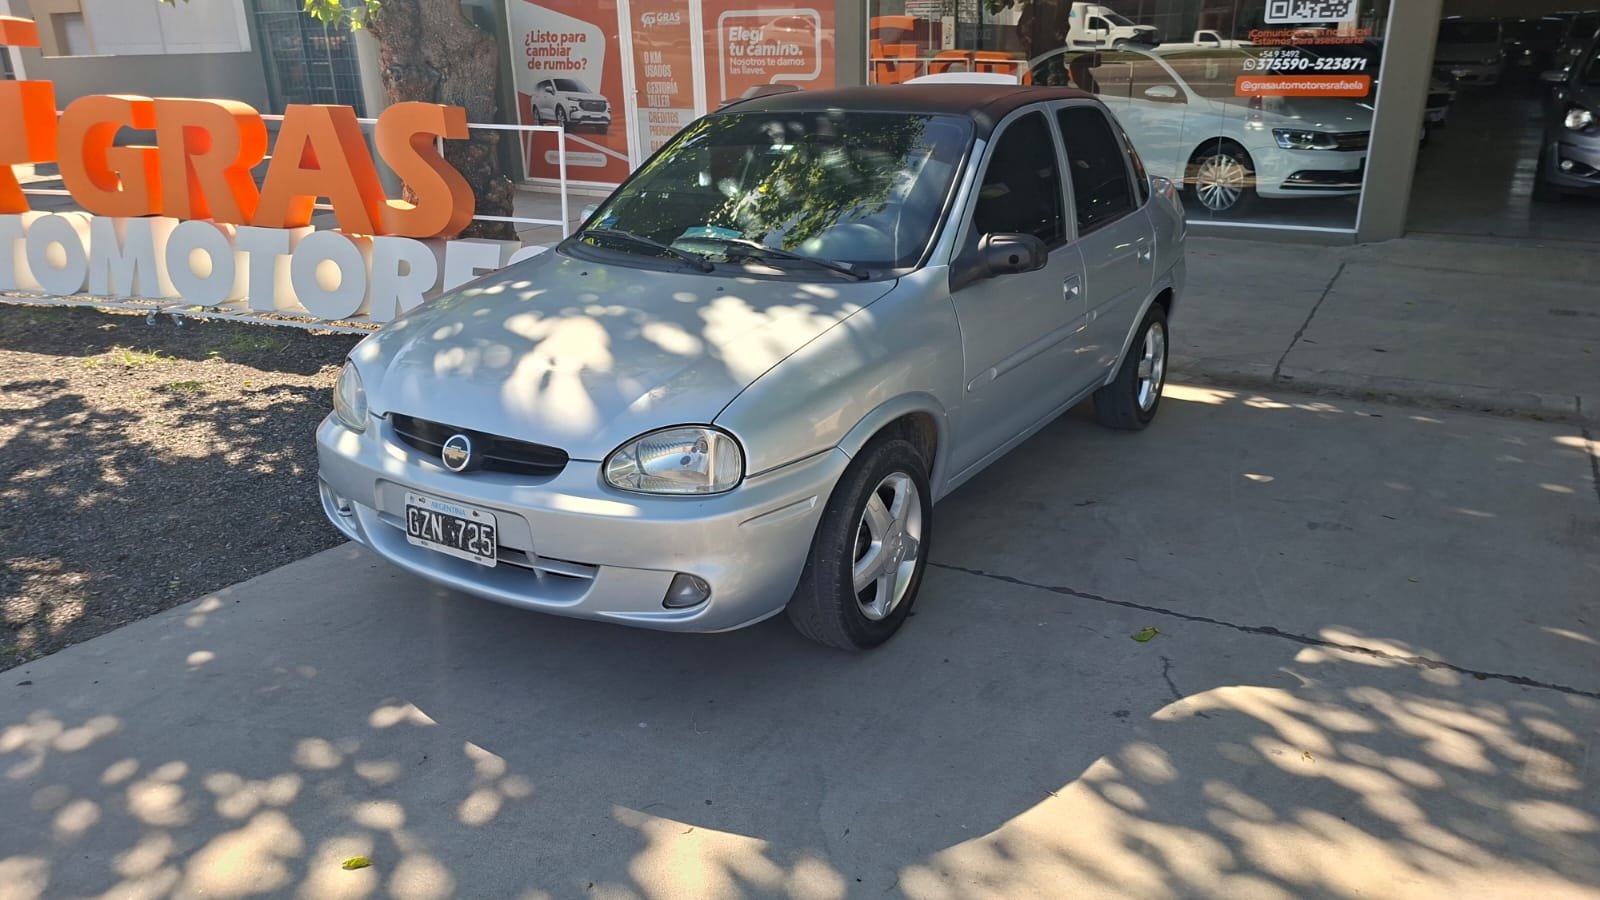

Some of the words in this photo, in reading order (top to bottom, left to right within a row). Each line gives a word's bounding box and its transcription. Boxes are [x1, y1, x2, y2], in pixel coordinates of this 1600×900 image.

[656, 12, 681, 22] GRAS
[525, 29, 558, 46] ¿Listo
[560, 33, 587, 46] para
[1253, 36, 1291, 45] Estamos
[1291, 37, 1313, 46] para
[526, 43, 571, 57] cambiar
[729, 42, 744, 56] tu
[747, 40, 803, 56] camino.
[1281, 50, 1300, 58] 3492
[528, 57, 542, 70] de
[543, 57, 588, 70] rumbo?
[730, 57, 766, 66] Nosotros
[767, 57, 776, 66] te
[777, 57, 806, 67] damos
[1256, 57, 1367, 70] 375590-523871
[645, 64, 672, 77] USADOS
[730, 66, 741, 74] las
[742, 66, 766, 75] llaves.
[1242, 81, 1363, 92] @grasautomotoresrafaela
[647, 95, 670, 107] TALLER
[57, 94, 474, 239] GRAS
[408, 508, 443, 542] GZN
[455, 520, 492, 556] 725
